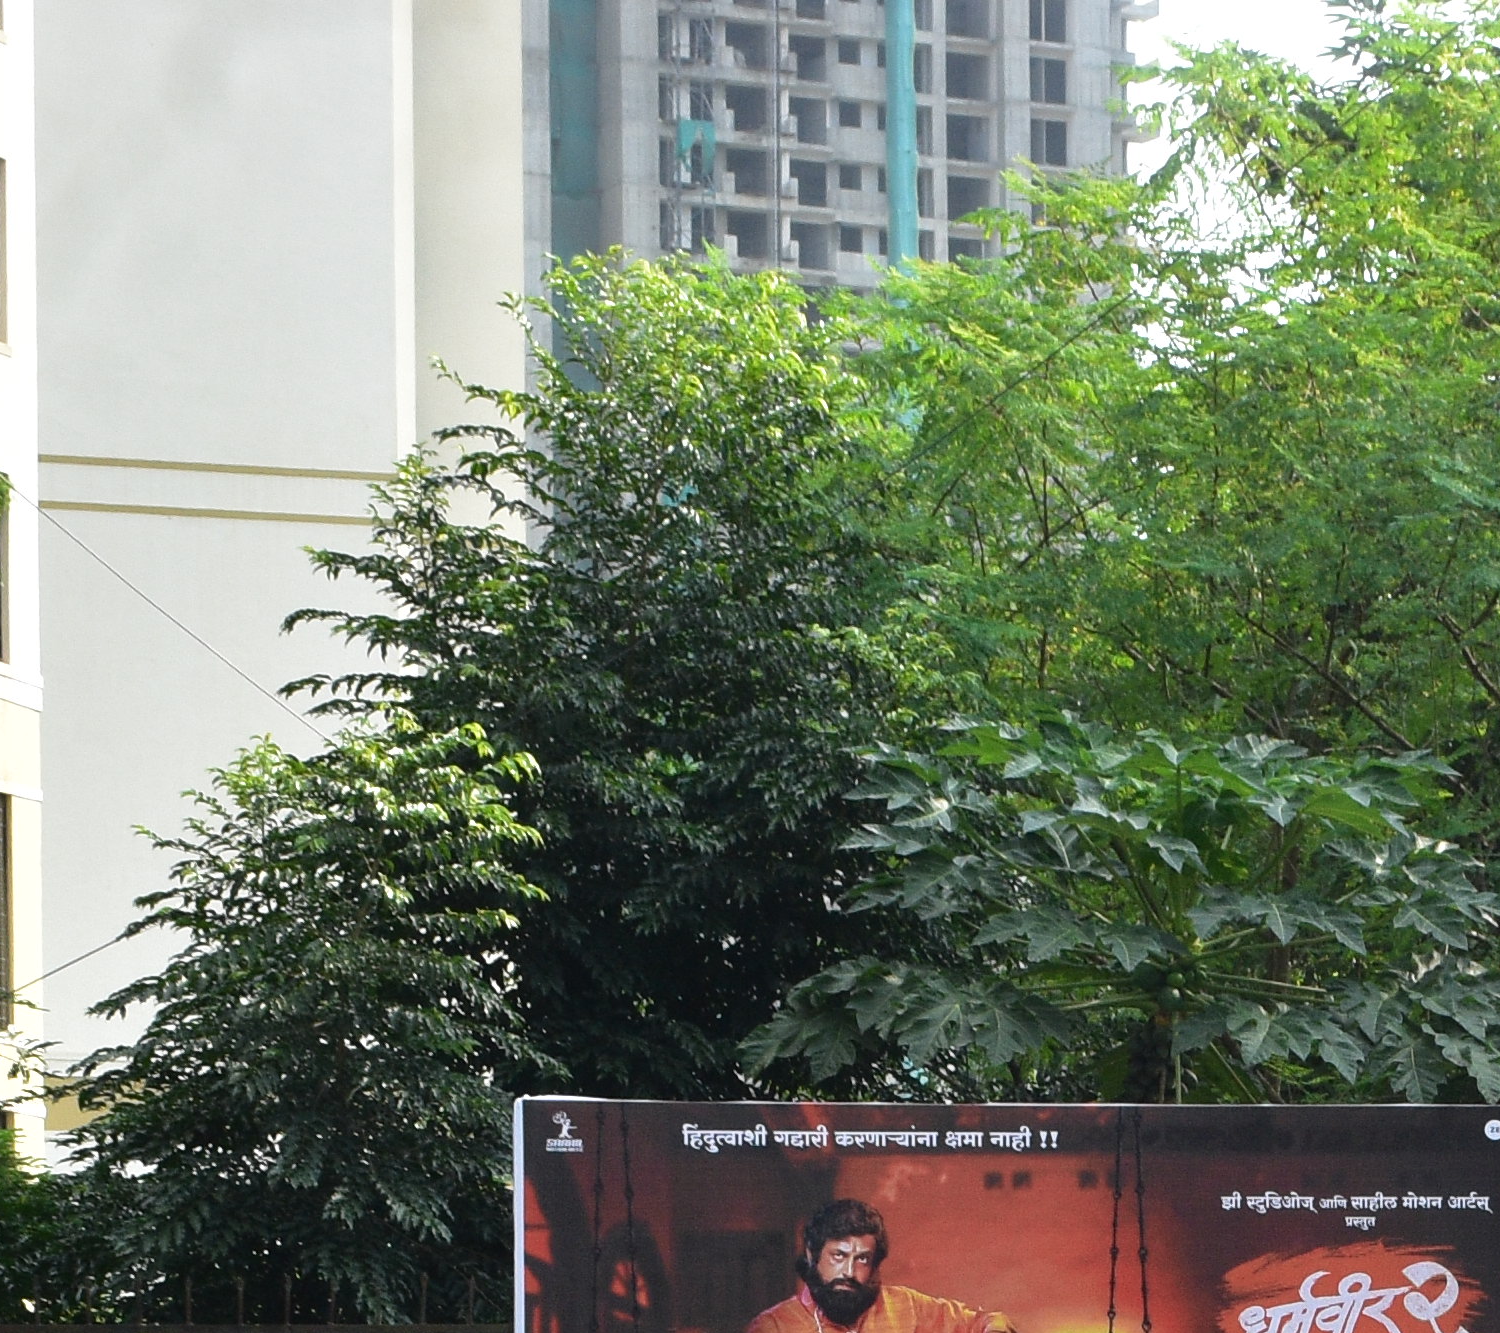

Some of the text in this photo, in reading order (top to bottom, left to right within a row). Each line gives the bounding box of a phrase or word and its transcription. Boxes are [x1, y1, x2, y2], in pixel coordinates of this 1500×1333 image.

[682, 1124, 768, 1152] हिंदुत्वाशी
[774, 1124, 828, 1149] गद्दारी
[834, 1125, 938, 1149] करणाऱ्यांना
[945, 1131, 983, 1148] क्षमा
[989, 1126, 1032, 1151] नाही
[1221, 1191, 1493, 1214] झी स्टुडिओज् आणि साहील मोशन आर्टस्
[1345, 1216, 1376, 1230] प्रस्तुत
